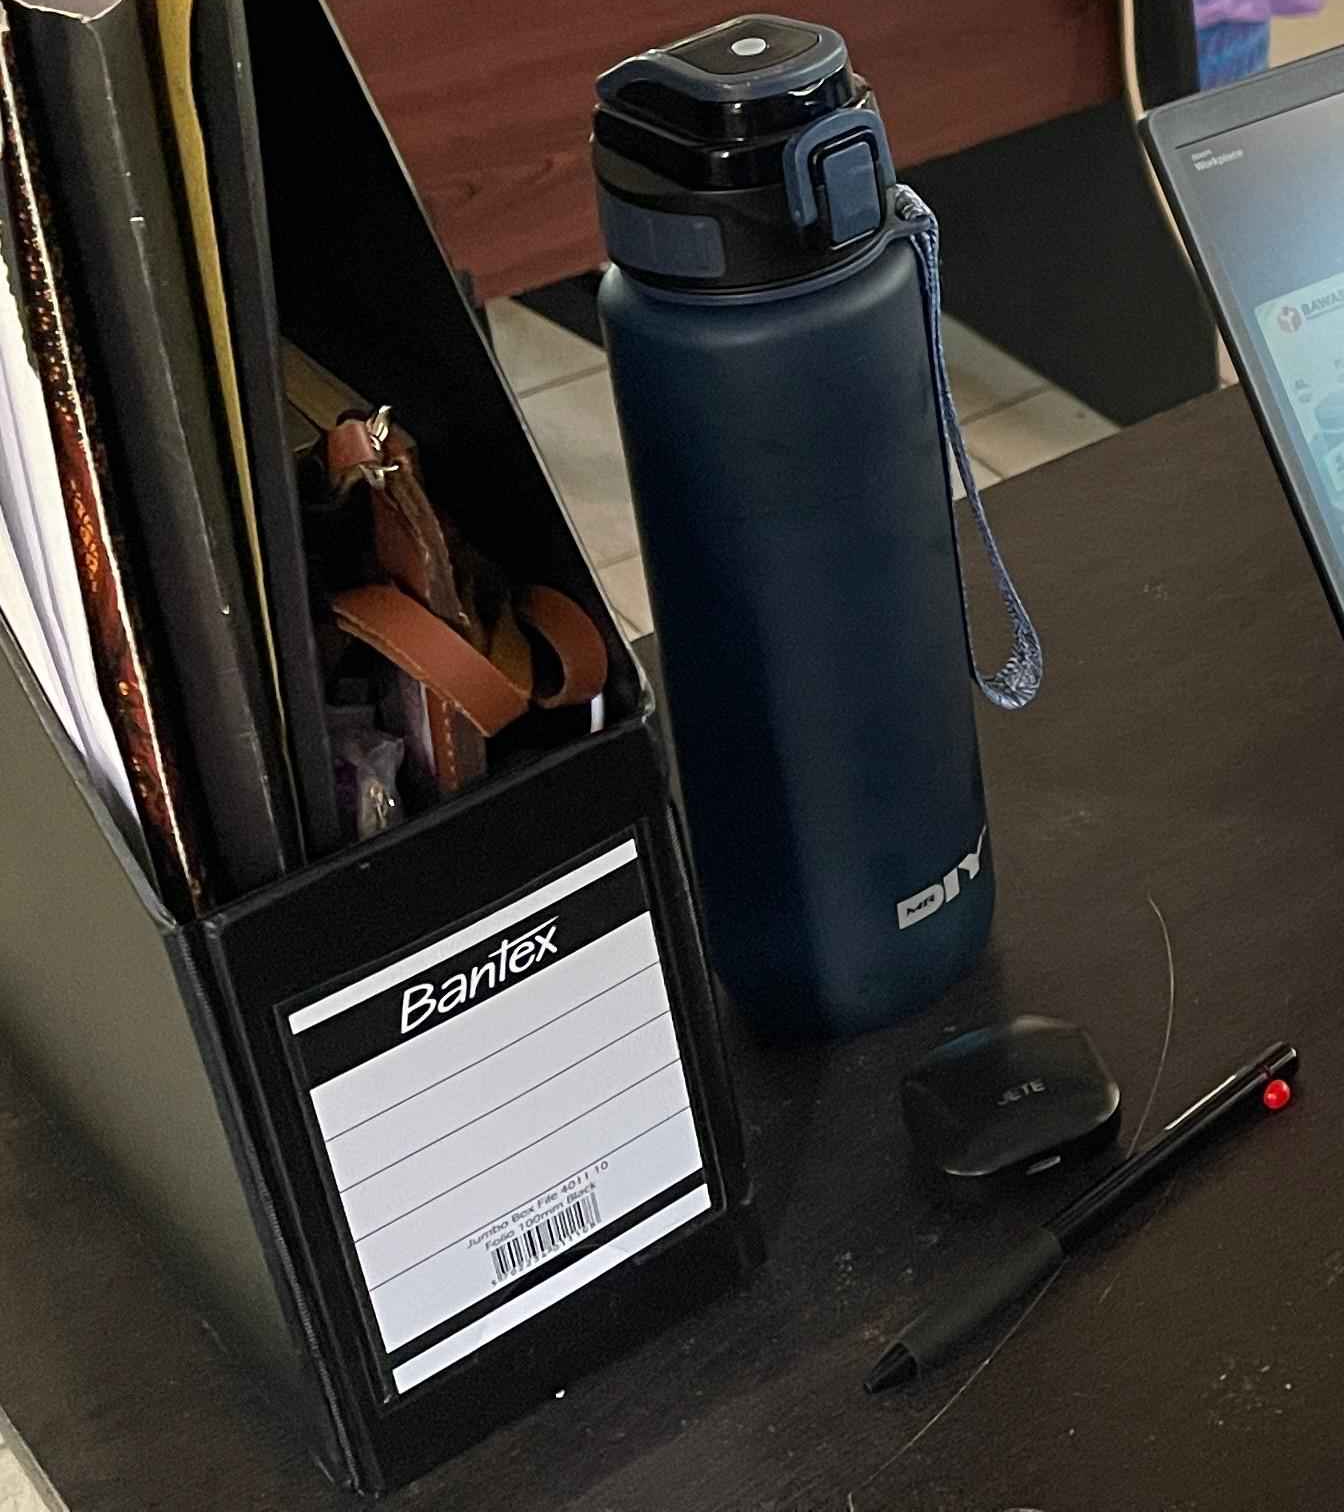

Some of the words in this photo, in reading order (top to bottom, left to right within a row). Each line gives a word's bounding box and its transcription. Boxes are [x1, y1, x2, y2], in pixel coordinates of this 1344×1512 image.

[400, 915, 559, 1034] Bantex
[466, 1219, 510, 1249] Jumbo
[511, 1206, 535, 1224] Box
[536, 1191, 559, 1210] File
[560, 1171, 590, 1194] 4011
[594, 1159, 610, 1175] 10
[484, 1229, 516, 1252] Folio
[519, 1201, 565, 1232] 100mm
[565, 1181, 597, 1205] Black
